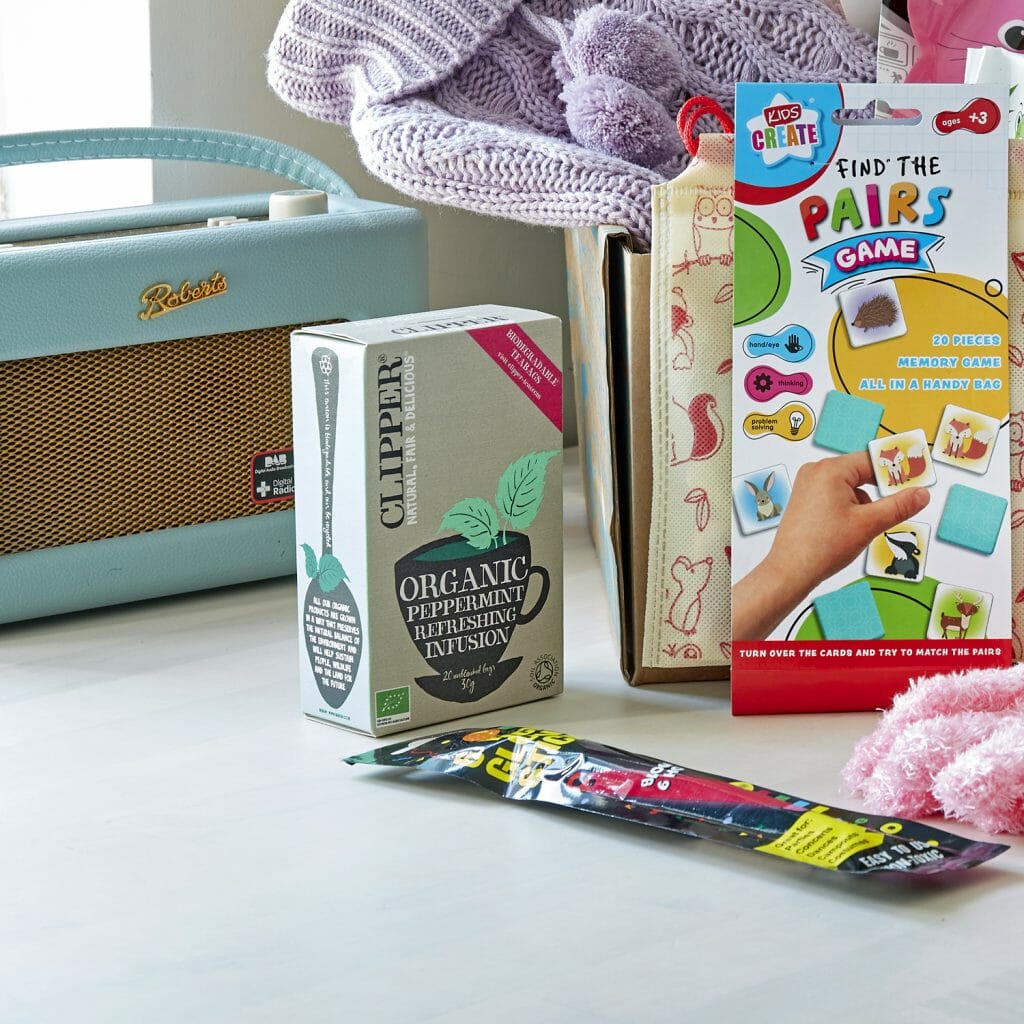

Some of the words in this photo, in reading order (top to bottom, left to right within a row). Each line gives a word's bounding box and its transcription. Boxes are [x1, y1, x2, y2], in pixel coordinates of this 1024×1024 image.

[768, 106, 800, 125] KIDS
[942, 117, 961, 127] ages
[969, 111, 988, 124] +3
[751, 122, 818, 152] CREATE
[836, 157, 886, 178] FIND
[897, 155, 941, 176] THE
[799, 181, 952, 242] PAIRS
[836, 237, 917, 269] GAME
[138, 271, 228, 321] Roberts
[749, 340, 780, 350] hand/eye
[933, 335, 949, 346] 20
[952, 335, 1001, 346] PIECES
[506, 328, 559, 388] BIODEGRADABLE
[510, 349, 542, 385] TEABAGS
[897, 357, 957, 368] MEMORY
[962, 357, 1001, 368] GAME
[404, 354, 417, 421] DELICIOUS
[778, 379, 805, 389] thinking
[859, 379, 887, 390] ALL
[890, 379, 905, 390] IN
[909, 379, 919, 390] A
[923, 379, 970, 390] HANDY
[974, 379, 1001, 390] BAG
[751, 418, 778, 427] problem
[751, 423, 774, 432] solving
[404, 436, 417, 462] FAIR
[272, 477, 292, 488] Digital
[400, 555, 529, 602] ORGANIC
[406, 585, 525, 623] PEPPERMINT
[414, 607, 517, 641] REFRESHING
[425, 627, 510, 659] INFUSION
[740, 649, 767, 658] TURN
[769, 649, 795, 657] OVER
[798, 649, 817, 657] THE
[820, 648, 852, 657] CARDS
[856, 648, 876, 657] AND
[878, 648, 897, 657] TRY
[900, 648, 913, 657] TO
[916, 648, 949, 656] MATCH
[951, 648, 970, 656] THE
[972, 648, 1001, 656] PAIRS
[858, 850, 893, 868] EASY
